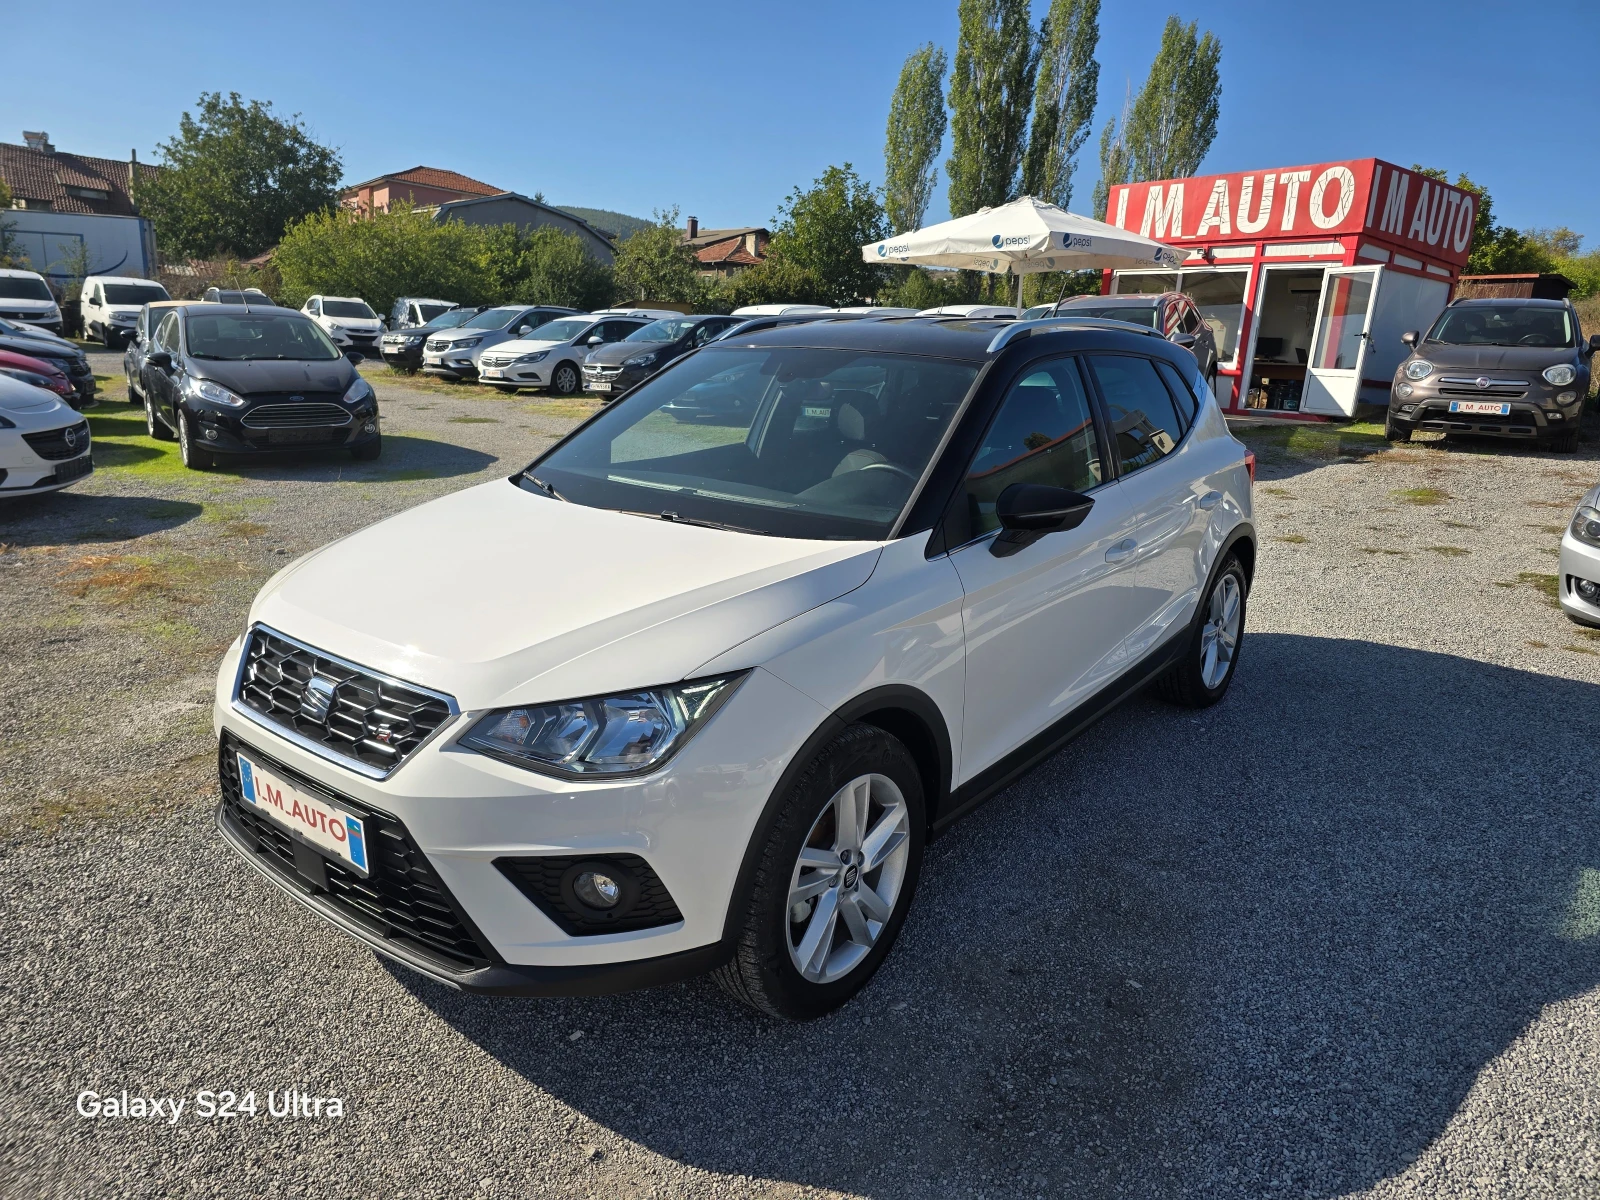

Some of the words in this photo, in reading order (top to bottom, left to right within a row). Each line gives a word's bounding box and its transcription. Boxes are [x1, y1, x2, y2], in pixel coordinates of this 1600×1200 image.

[1365, 165, 1382, 228] I
[1380, 170, 1409, 236] M
[1408, 181, 1473, 253] AUTO
[1005, 235, 1031, 247] pepsi
[1073, 237, 1092, 248] pepsi
[888, 243, 910, 255] pepsi
